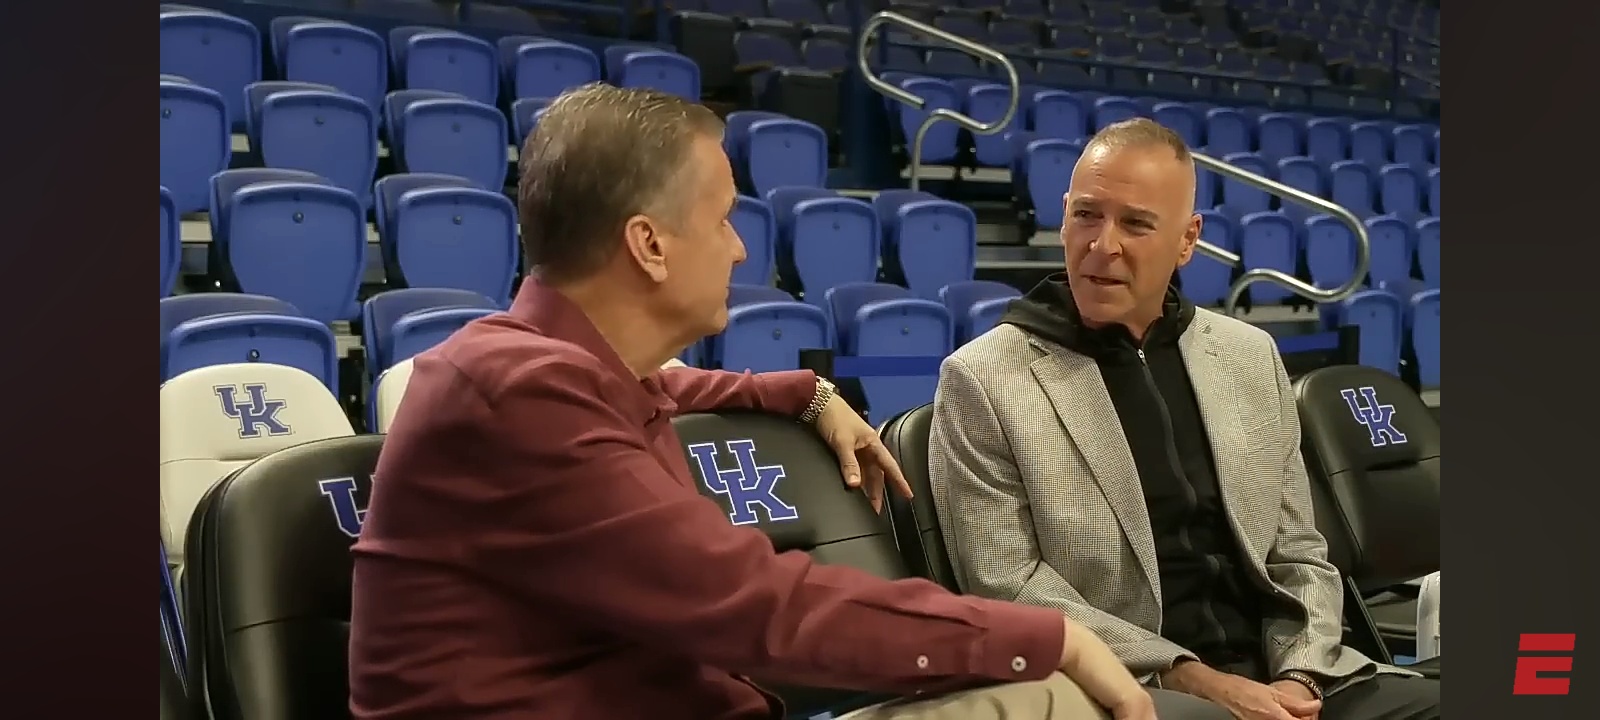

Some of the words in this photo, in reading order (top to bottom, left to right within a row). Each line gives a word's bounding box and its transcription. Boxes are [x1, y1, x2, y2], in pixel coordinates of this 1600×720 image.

[213, 383, 292, 439] UK
[1340, 386, 1408, 447] UK
[688, 439, 798, 526] UK
